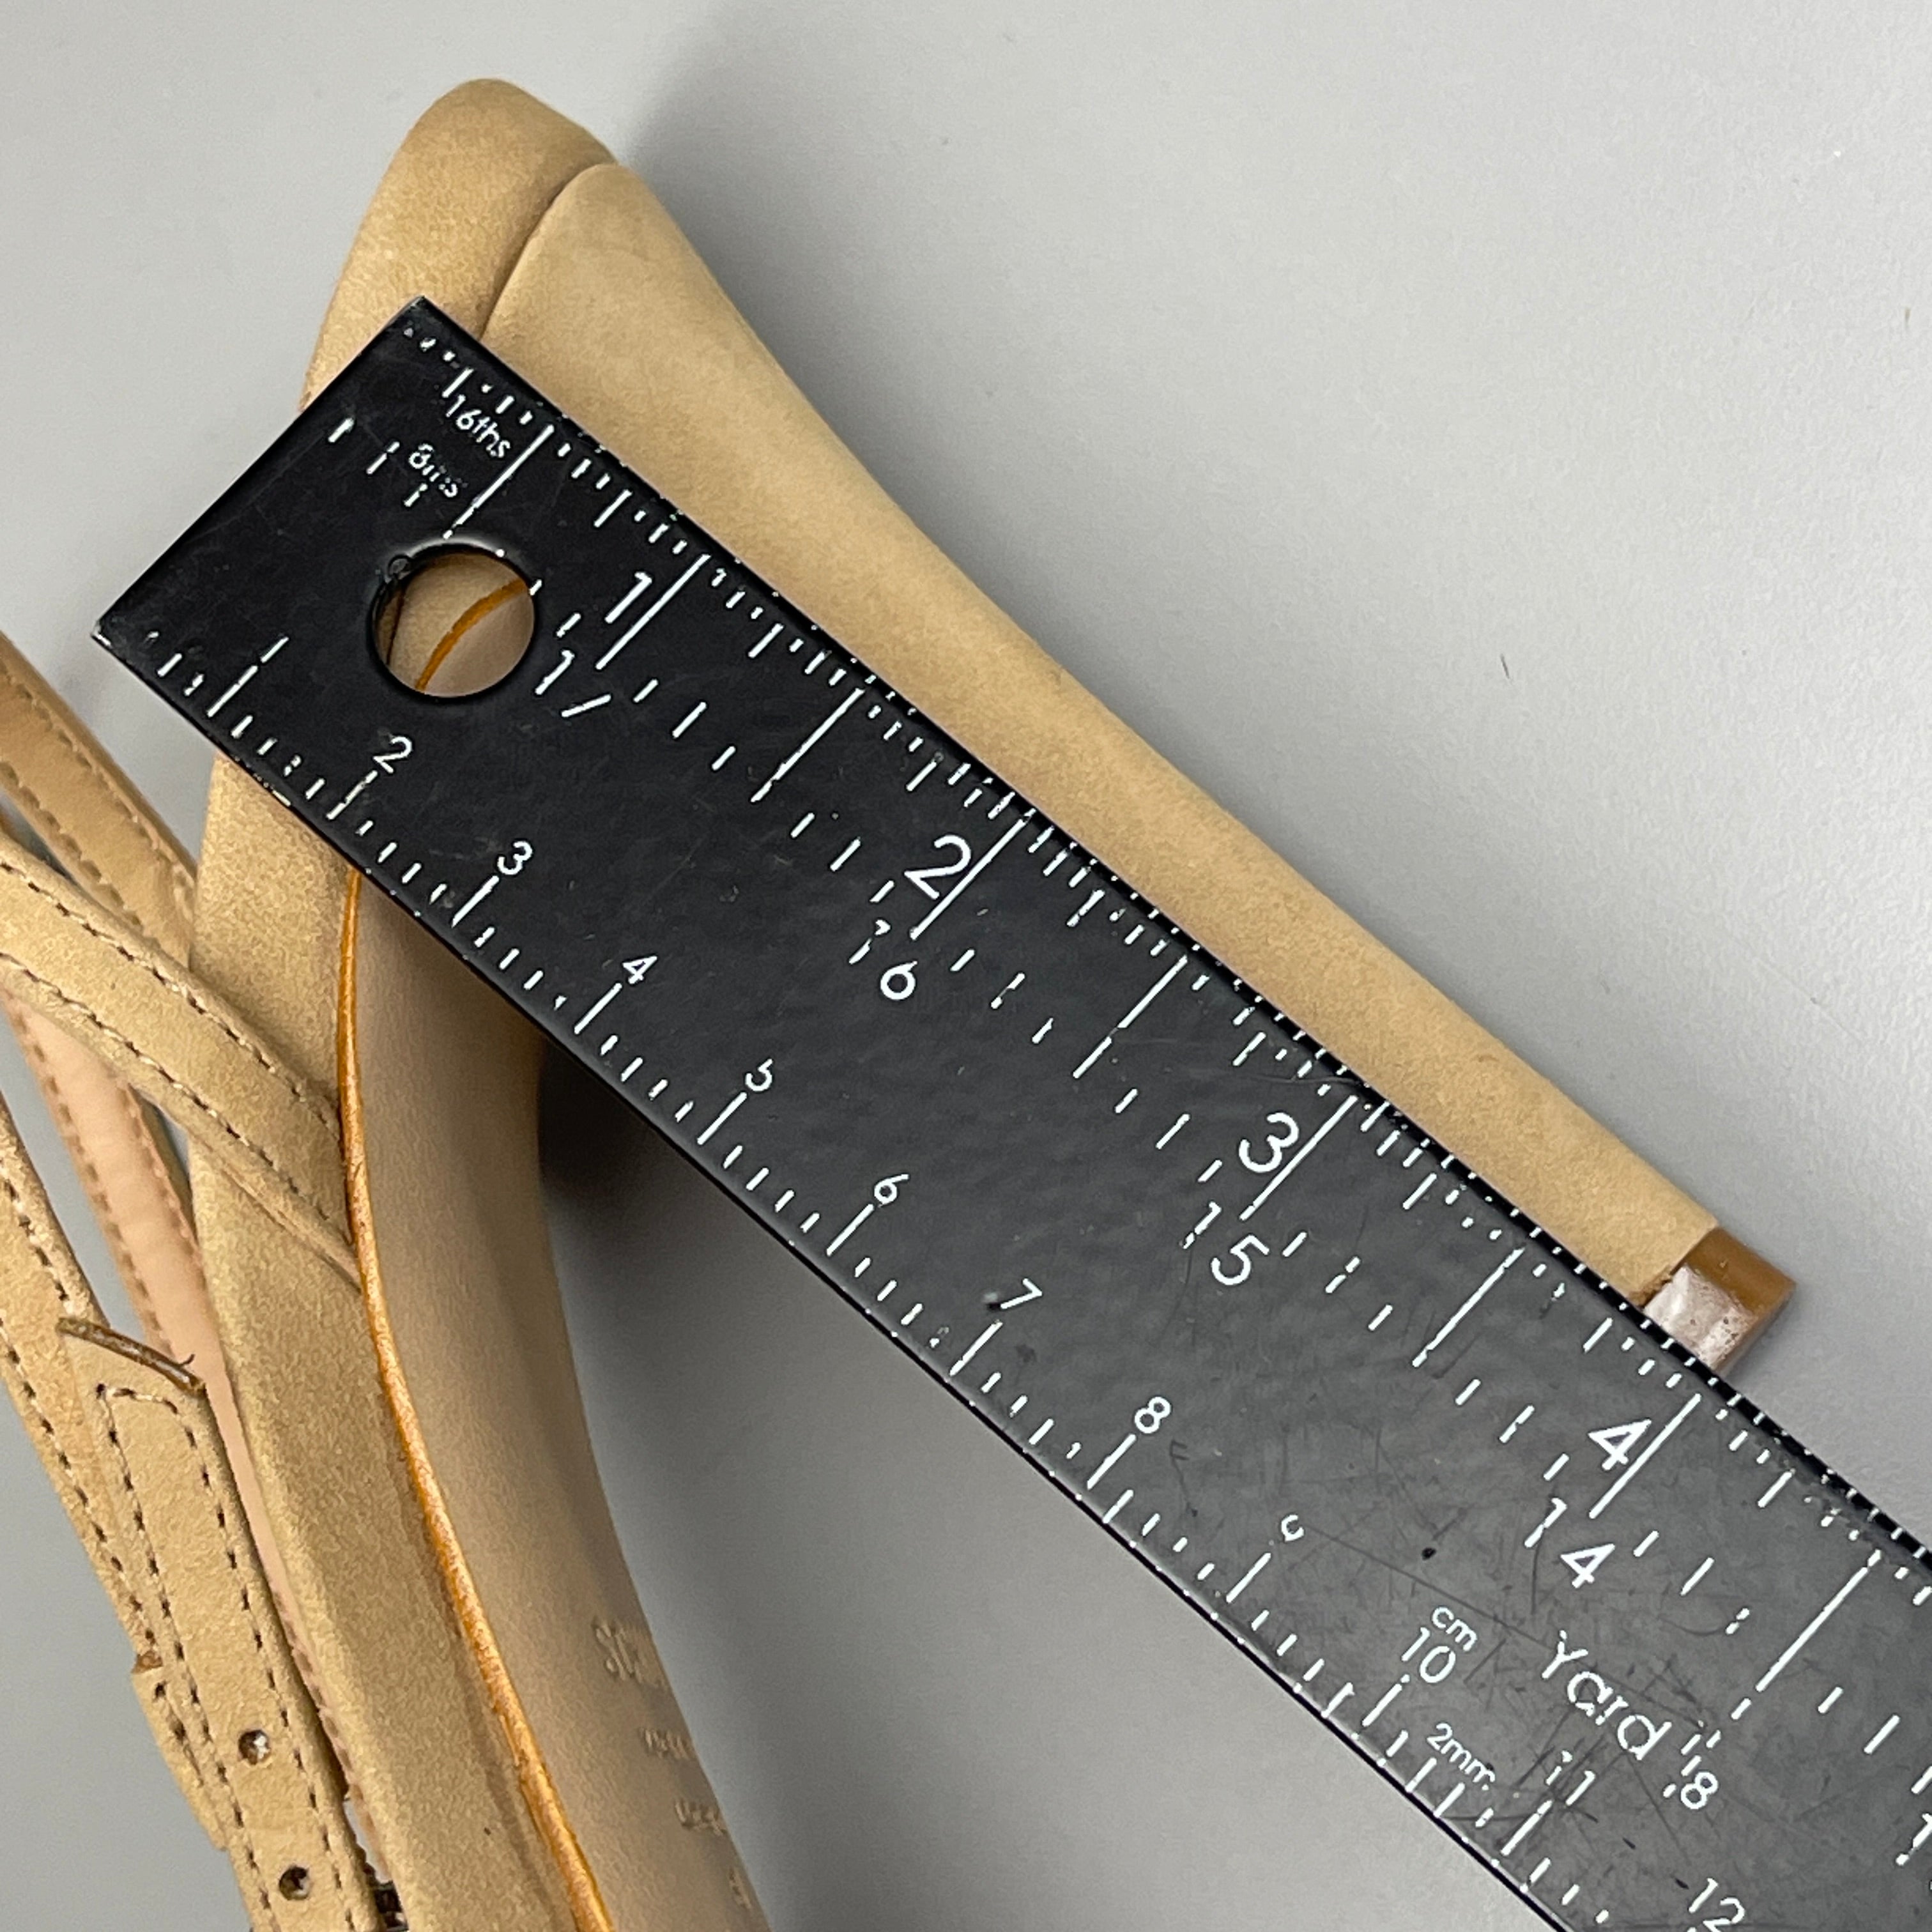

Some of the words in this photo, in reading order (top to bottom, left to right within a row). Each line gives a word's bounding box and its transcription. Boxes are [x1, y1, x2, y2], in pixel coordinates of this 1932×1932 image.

[445, 394, 511, 458] 16ths
[604, 572, 653, 624] 1
[373, 736, 413, 774] 2
[497, 841, 533, 875] 3
[904, 834, 972, 900] 2
[622, 956, 658, 985] 4
[848, 919, 918, 1000] 16
[1238, 1112, 1300, 1173] 3
[874, 1174, 910, 1205] 6
[1182, 1201, 1270, 1285] 15
[1000, 1278, 1043, 1310] 7
[1134, 1396, 1172, 1434] 8
[1588, 1418, 1652, 1471] 4
[1524, 1497, 1615, 1588] 14
[1401, 1626, 1457, 1684] 10
[1430, 1606, 1478, 1652] cm
[1540, 1629, 1673, 1761] Yard
[1688, 1877, 1745, 1932] 12
